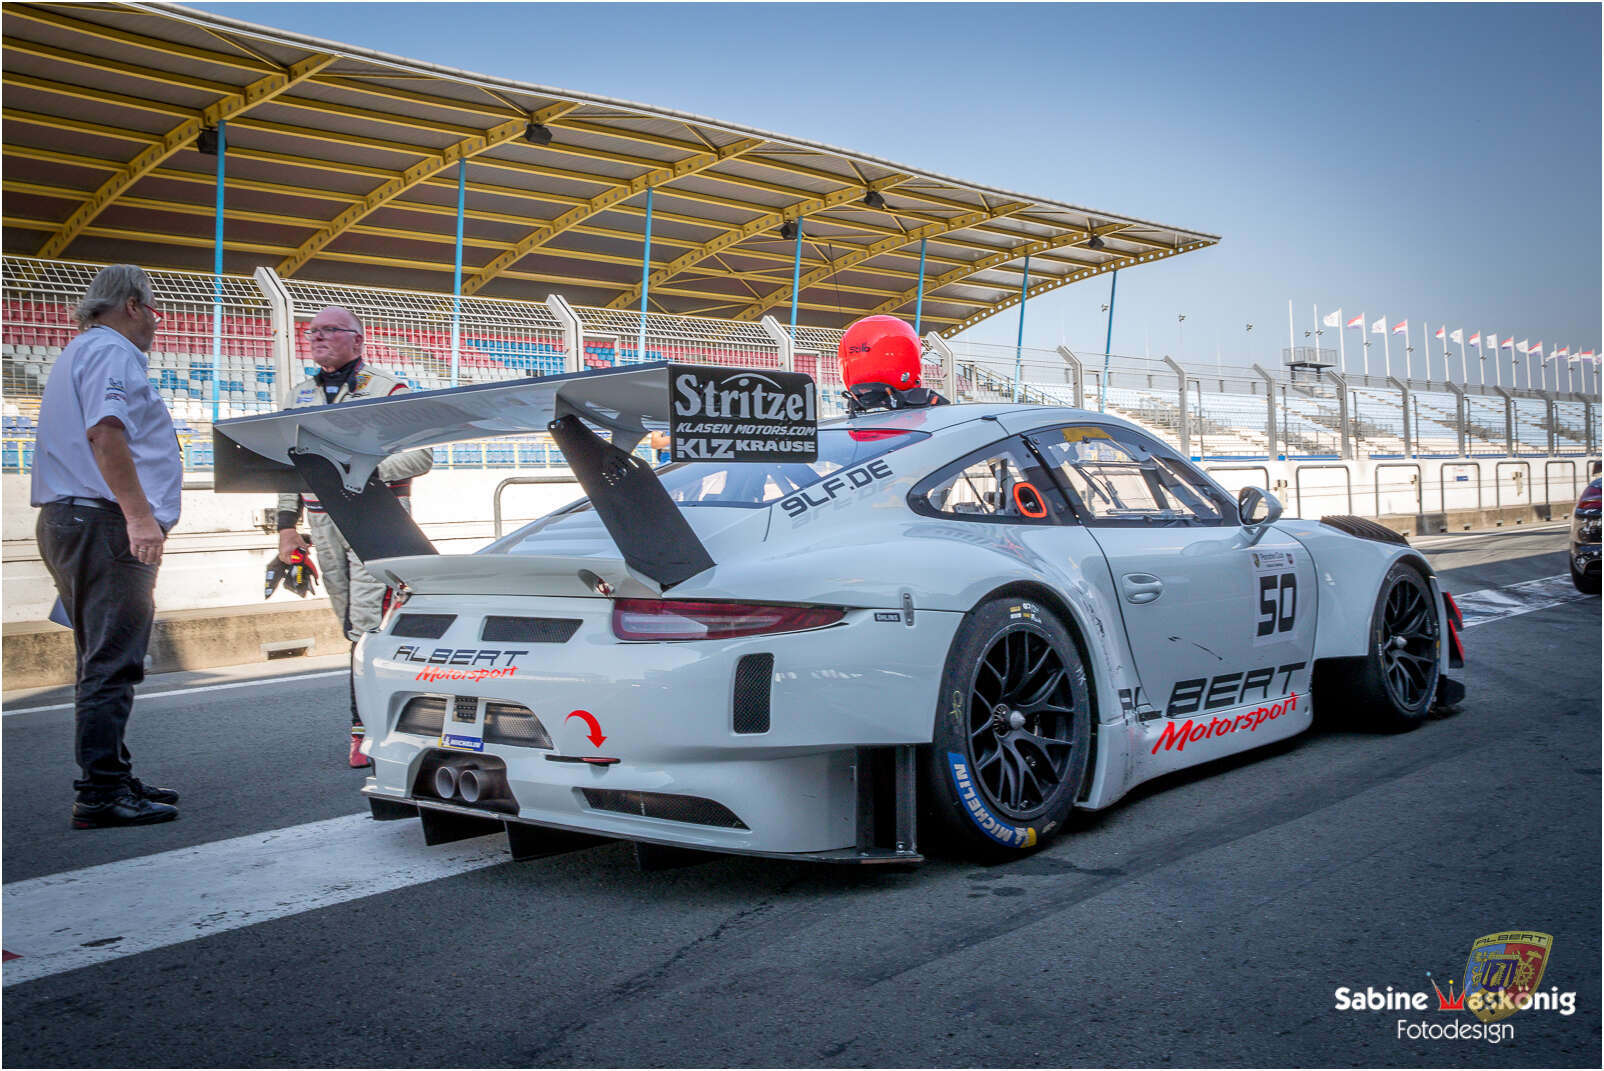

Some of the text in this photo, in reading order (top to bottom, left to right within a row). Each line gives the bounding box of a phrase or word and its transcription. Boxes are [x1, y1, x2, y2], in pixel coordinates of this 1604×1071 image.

[674, 373, 816, 421] Stritzel
[676, 422, 816, 436] KLASEN MOTORS.COM
[736, 439, 816, 453] KRAUSE
[676, 438, 735, 459] KLZ
[780, 459, 894, 518] 9LF.DE
[1256, 572, 1297, 637] 50
[393, 646, 529, 666] ALBERT
[415, 666, 519, 683] Motorsport
[1151, 692, 1299, 755] Motorsport
[953, 763, 1014, 843] MICHELIN
